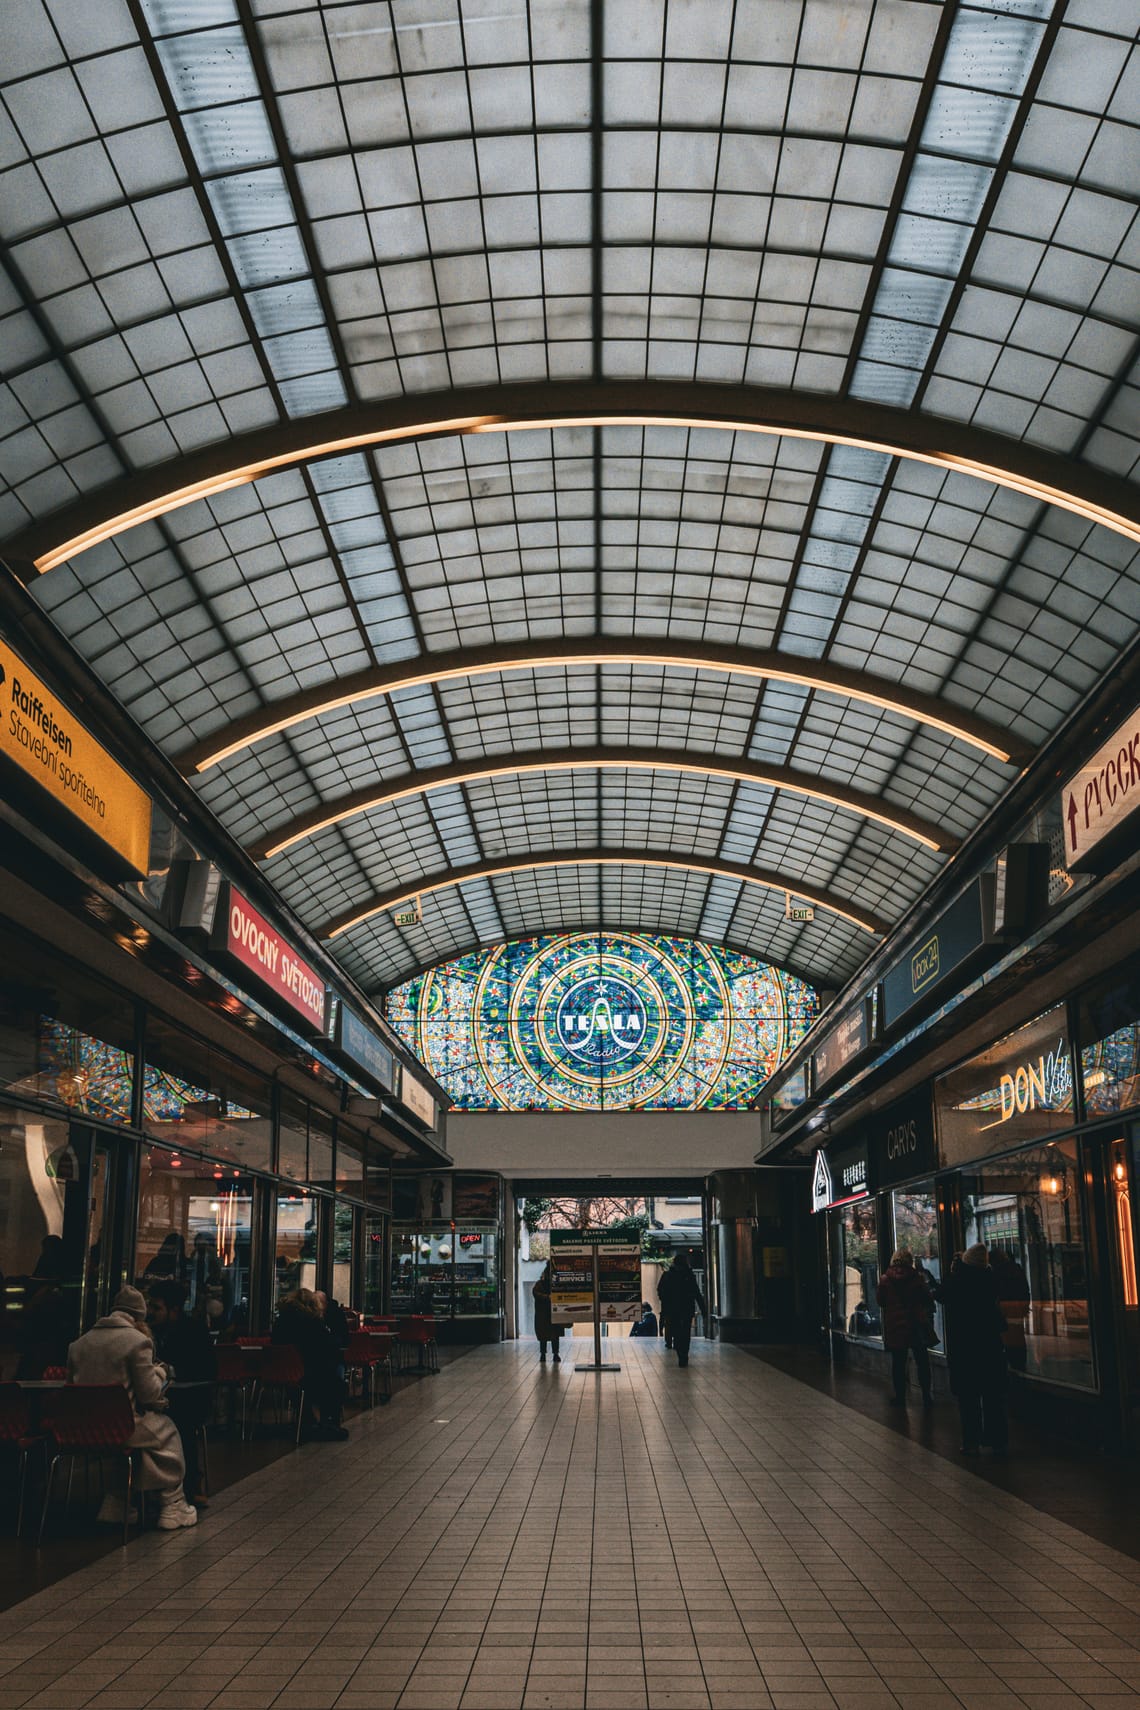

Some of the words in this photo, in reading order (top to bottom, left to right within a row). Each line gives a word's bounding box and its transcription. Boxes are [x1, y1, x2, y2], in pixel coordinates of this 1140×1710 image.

[12, 677, 73, 758] Raiffeisen
[9, 709, 59, 774] Stavební
[59, 762, 106, 819] spořitelna
[400, 912, 415, 923] EXIT
[793, 909, 808, 919] EXIT
[231, 905, 279, 974] OVOCNÝ
[562, 1014, 641, 1031] TESLA
[581, 1042, 621, 1057] Radio
[1000, 1055, 1046, 1121] DON
[887, 1119, 917, 1160] CARYS
[460, 1234, 481, 1243] OPEN
